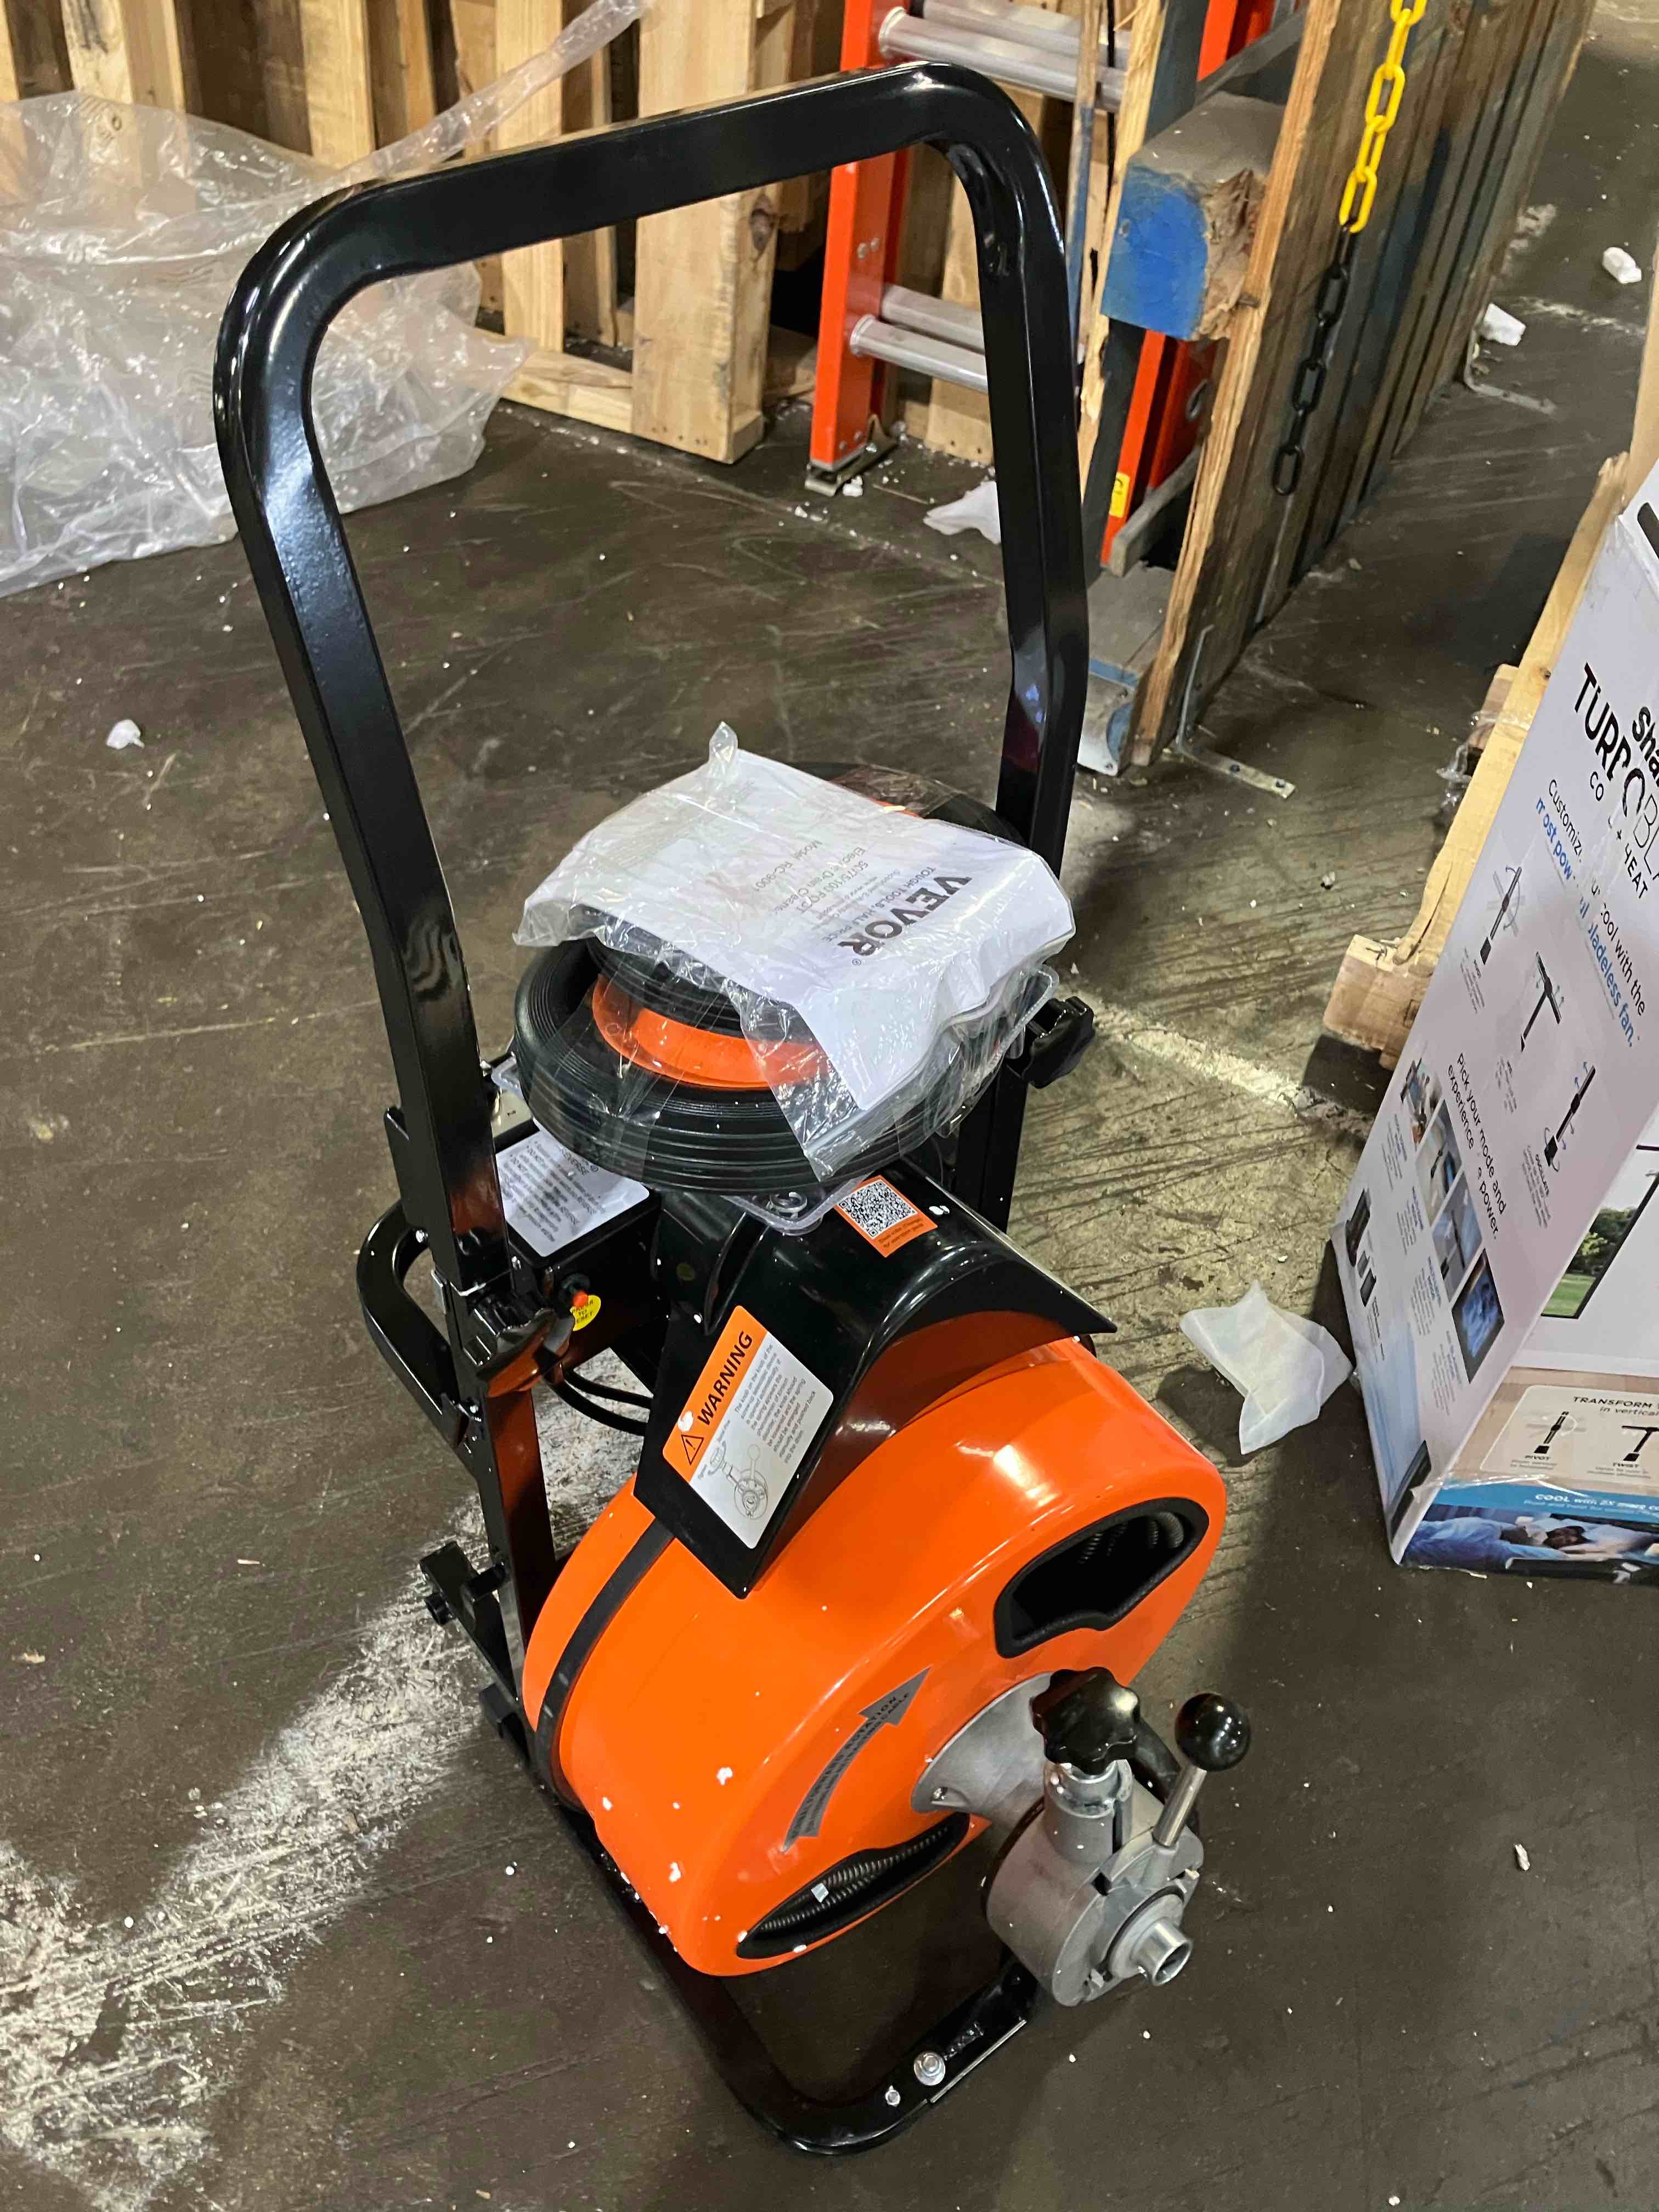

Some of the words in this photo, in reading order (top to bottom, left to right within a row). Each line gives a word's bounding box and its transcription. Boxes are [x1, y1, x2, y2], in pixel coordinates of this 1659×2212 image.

[838, 877, 972, 956] VEVOR
[905, 866, 936, 889] TOUGH
[1549, 779, 1582, 863] Customiz
[1615, 939, 1633, 983] with
[1630, 979, 1645, 1016] the
[1448, 1064, 1475, 1150] experience
[1479, 1180, 1498, 1240] power.
[1457, 1053, 1470, 1091] Pick
[1466, 1089, 1481, 1126] your
[1480, 1128, 1494, 1178] mode
[1493, 1180, 1506, 1215] and
[698, 1331, 753, 1425] WARNING
[1573, 1396, 1652, 1408] TRANSFORM
[1536, 1494, 1570, 1502] COOL
